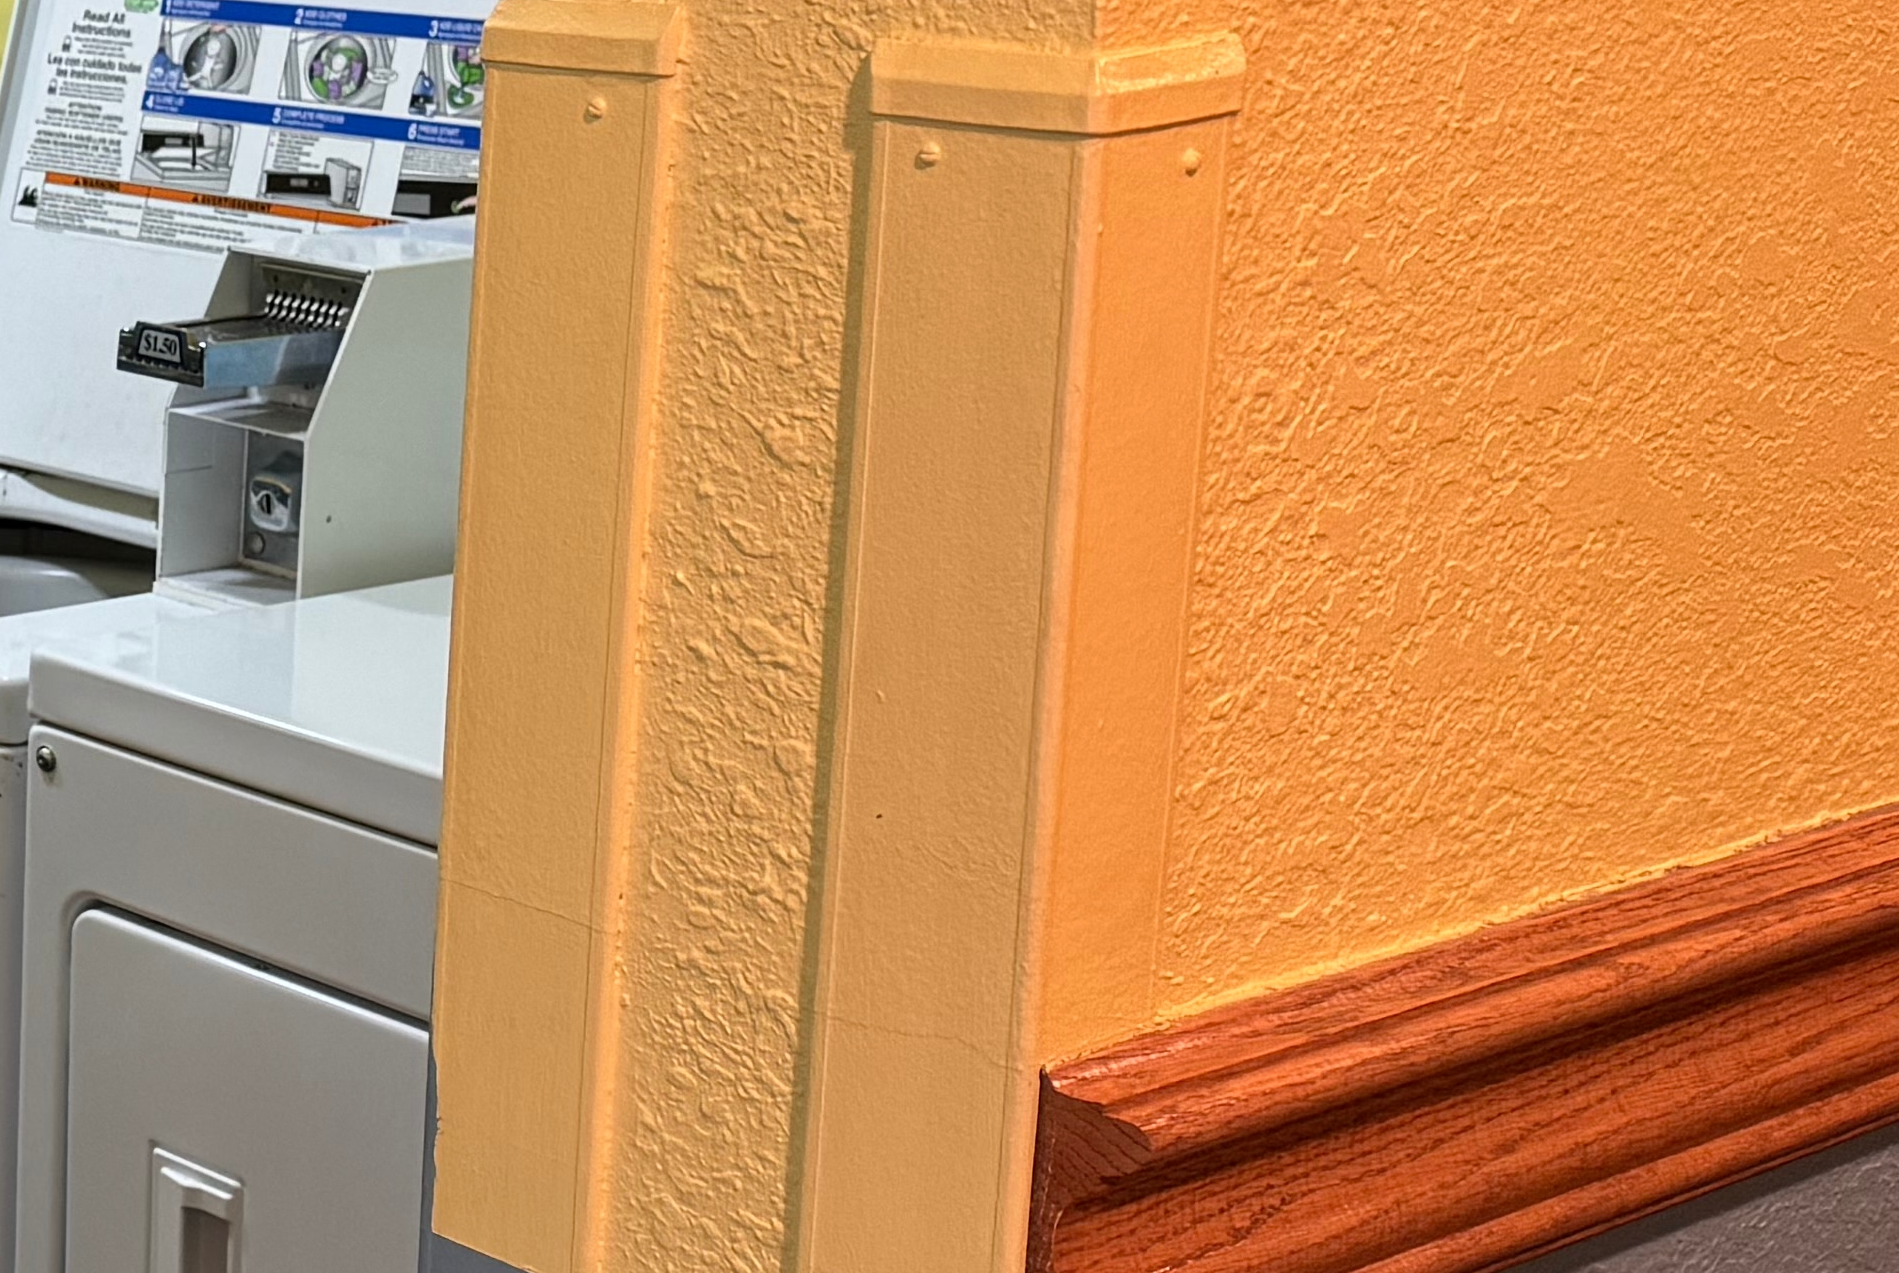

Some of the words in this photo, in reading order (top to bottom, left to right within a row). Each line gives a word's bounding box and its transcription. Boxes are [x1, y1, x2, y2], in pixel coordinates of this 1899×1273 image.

[82, 8, 111, 24] Read
[407, 122, 418, 141] 6
[143, 332, 178, 356] $1.50
